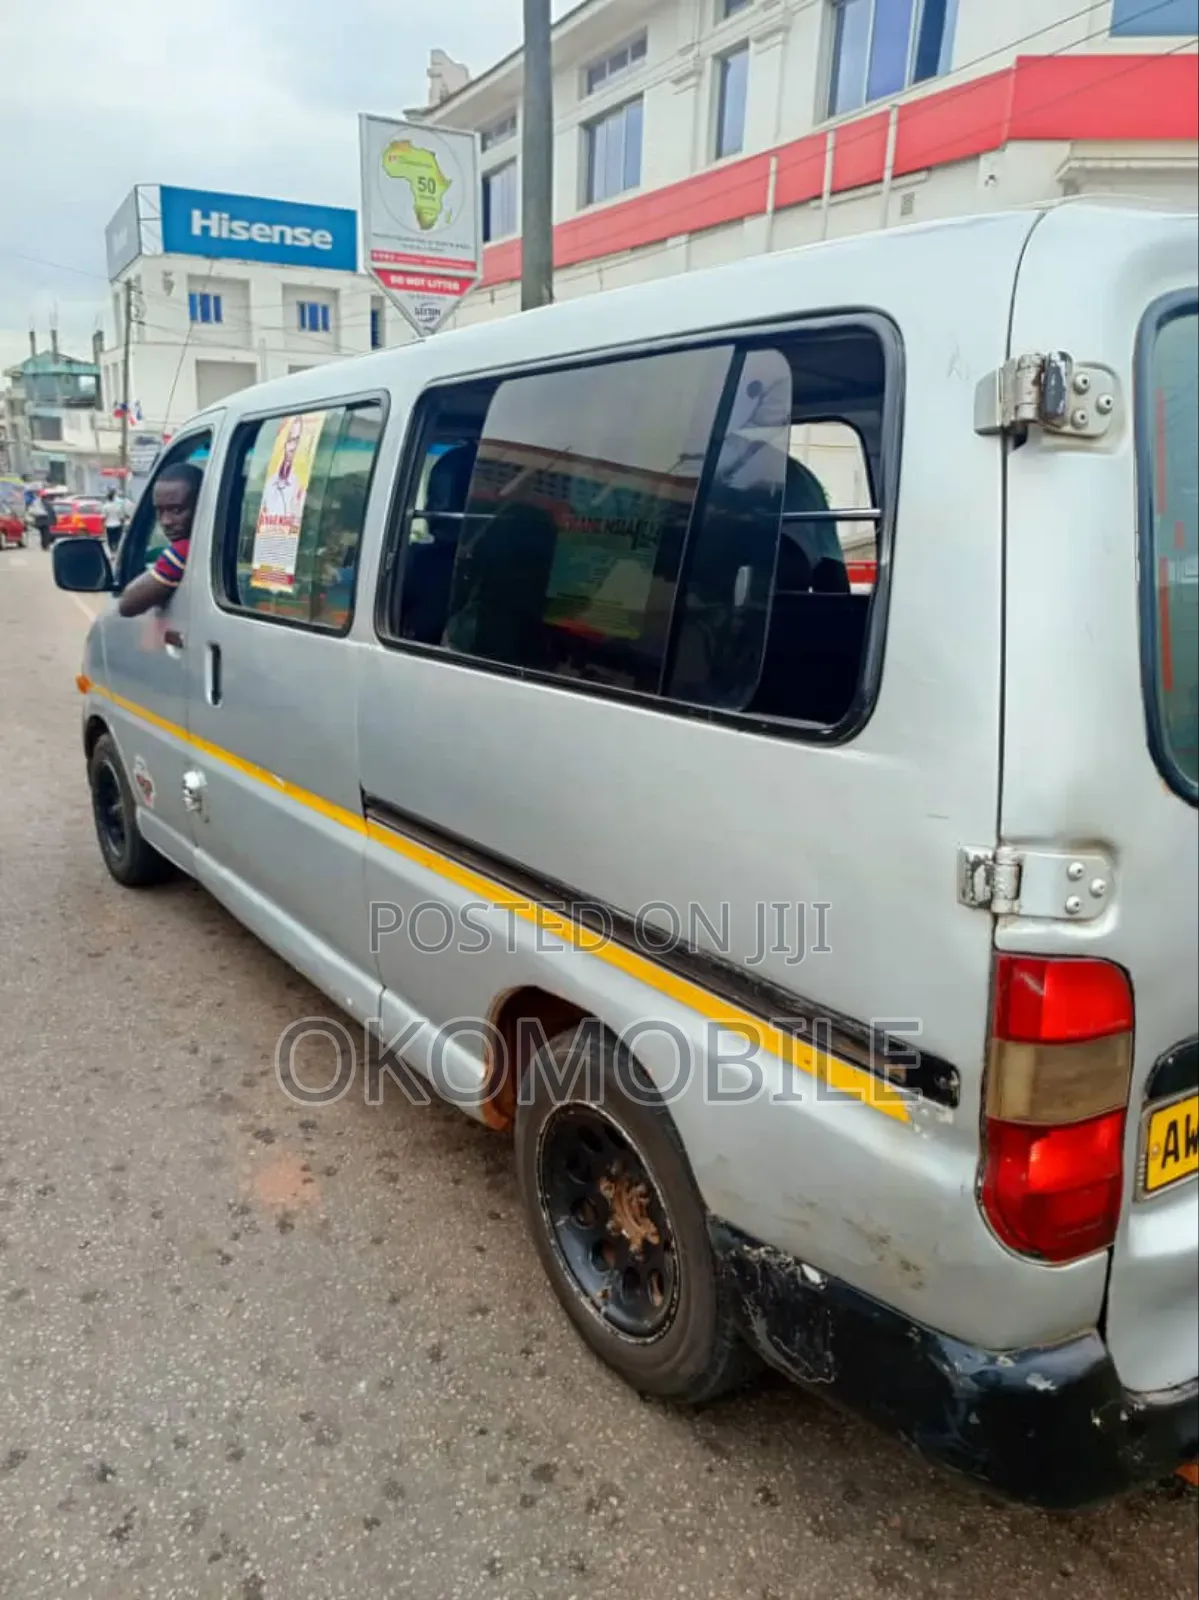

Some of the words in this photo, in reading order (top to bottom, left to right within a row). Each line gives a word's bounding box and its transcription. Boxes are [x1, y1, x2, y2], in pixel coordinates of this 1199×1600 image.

[417, 176, 437, 195] 50
[190, 208, 333, 250] Hisense
[390, 275, 404, 285] DO
[406, 276, 425, 288] NOT
[427, 278, 461, 291] LITTER
[1161, 1112, 1198, 1170] AW
